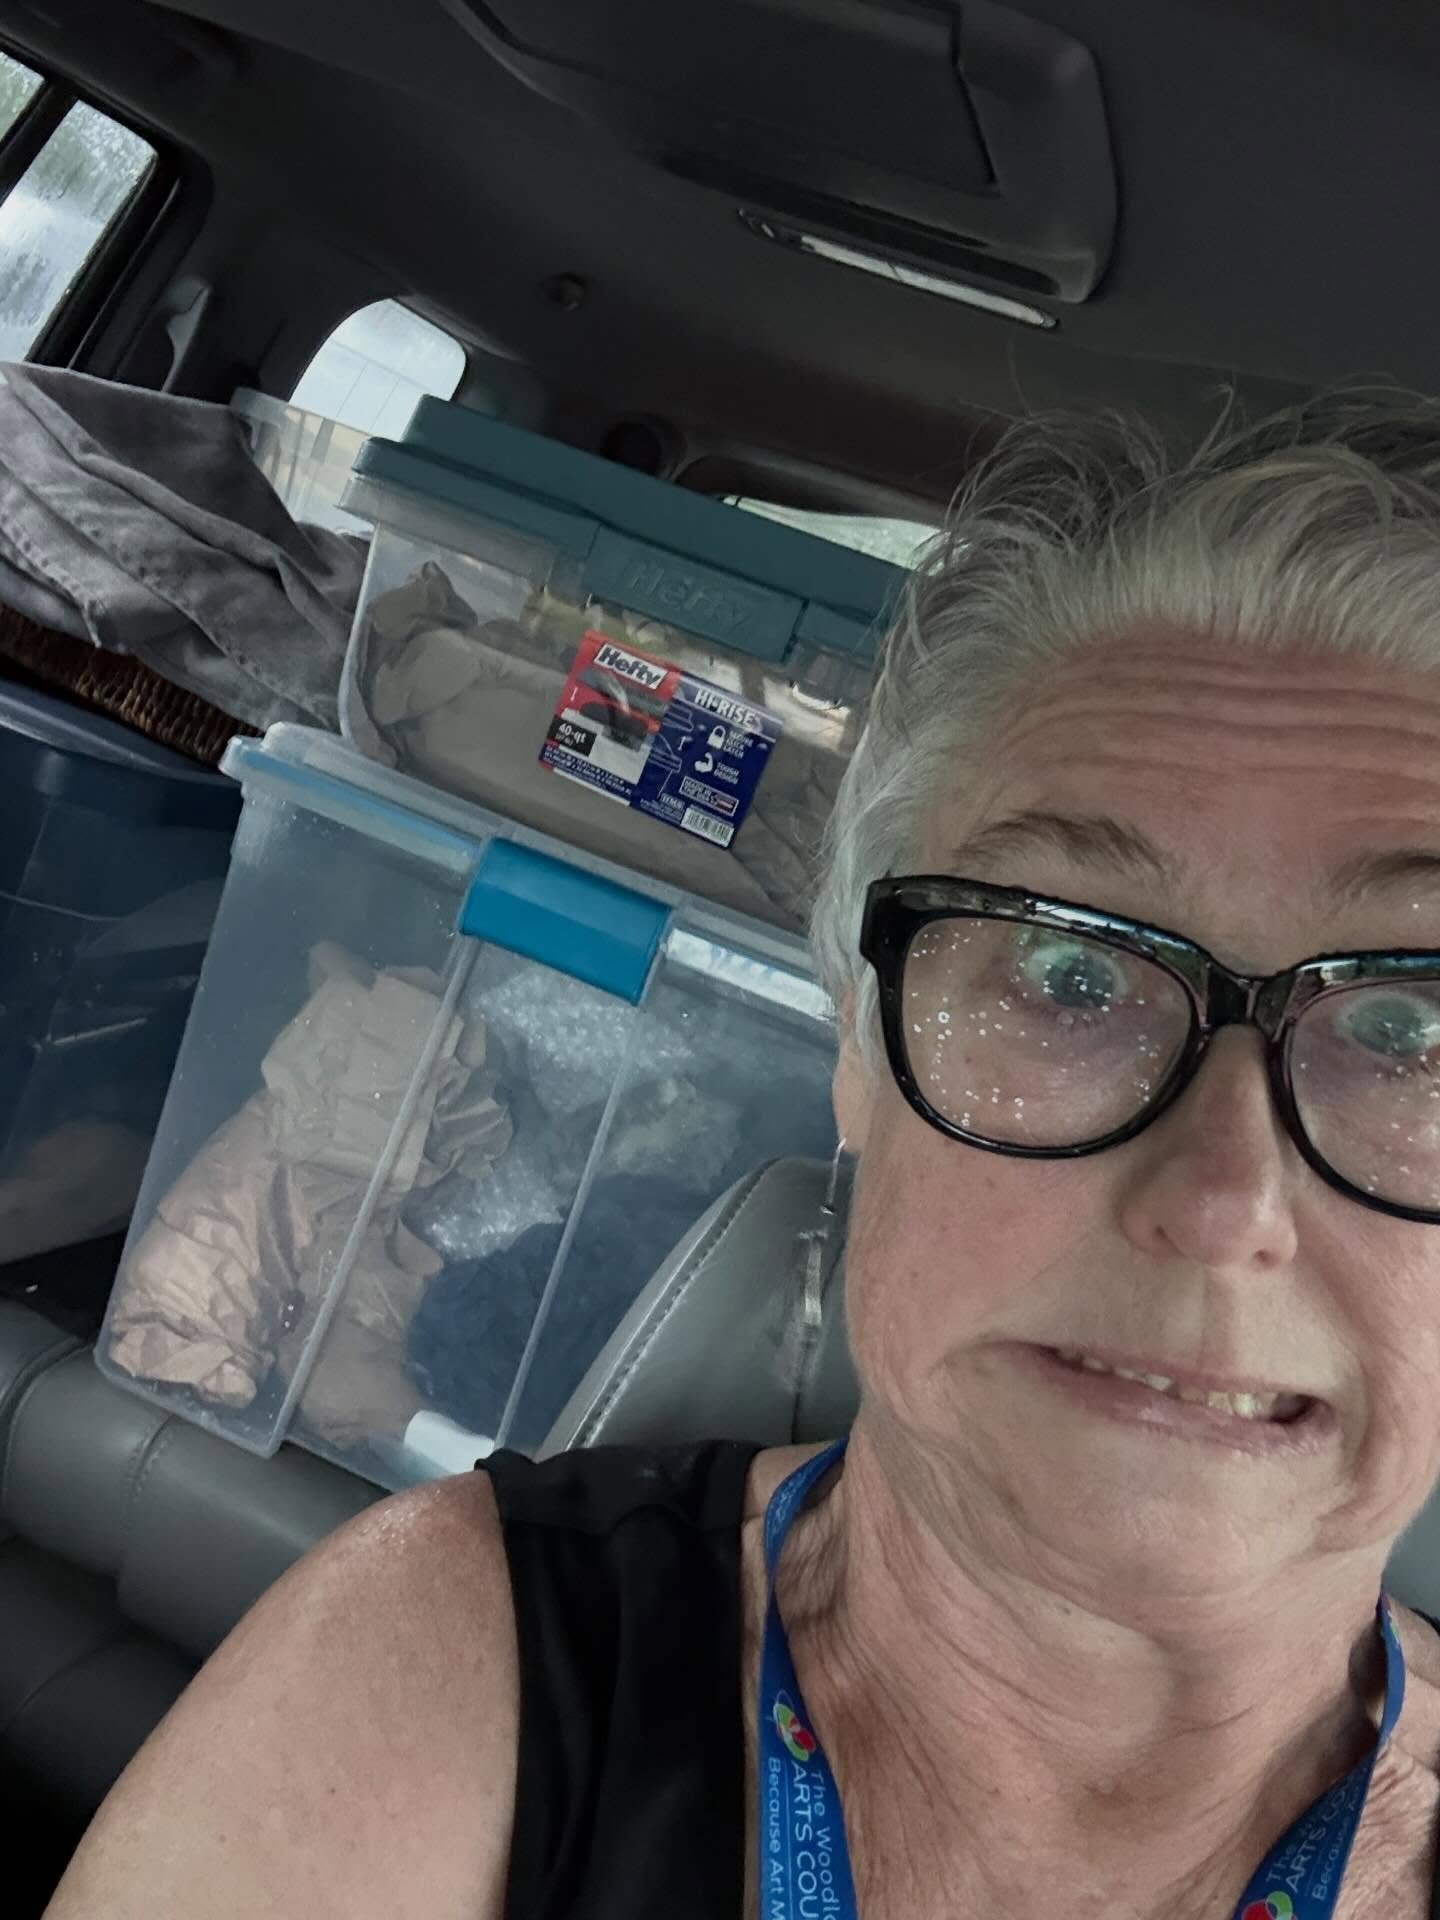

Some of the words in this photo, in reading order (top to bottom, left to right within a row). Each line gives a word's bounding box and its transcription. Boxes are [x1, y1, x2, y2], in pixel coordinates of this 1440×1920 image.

[598, 646, 661, 687] Hefty
[559, 722, 587, 744] 40-qt
[768, 1757, 781, 1853] Because
[791, 1760, 813, 1841] ARTS
[811, 1769, 826, 1816] The
[769, 1859, 784, 1894] Art
[1286, 1827, 1327, 1893] ARTS
[771, 1901, 785, 1920] M
